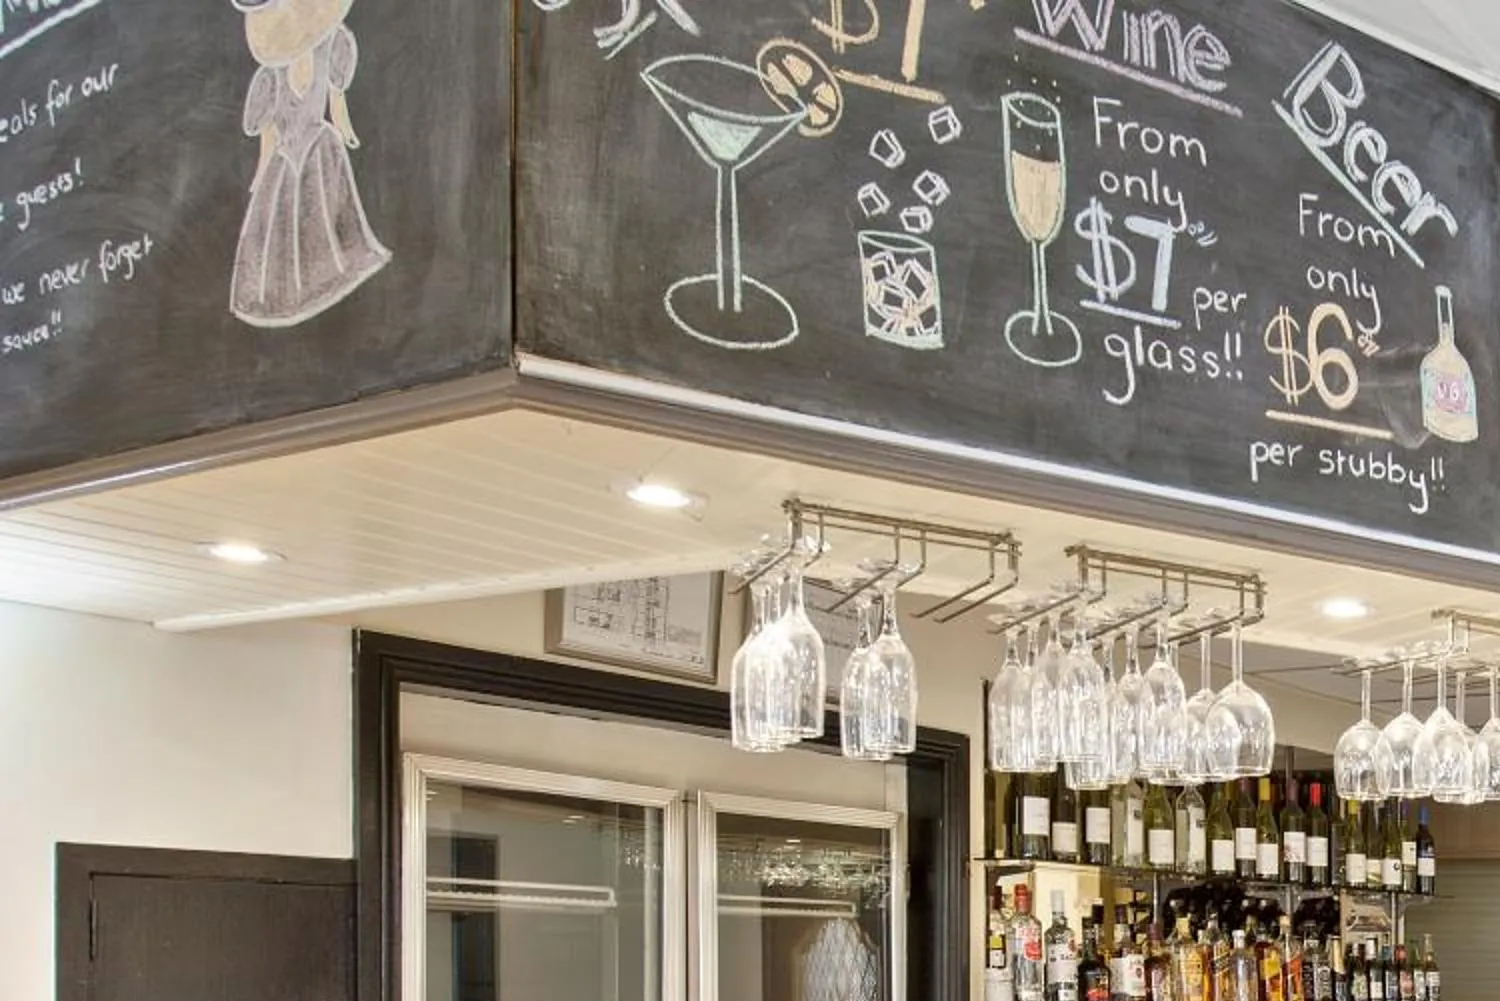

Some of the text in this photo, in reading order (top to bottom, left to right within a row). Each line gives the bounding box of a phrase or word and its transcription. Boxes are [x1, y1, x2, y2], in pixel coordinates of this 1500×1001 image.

[46, 79, 74, 127] for
[81, 63, 119, 97] our
[1092, 96, 1208, 166] From
[1284, 40, 1459, 239] Beer
[1099, 169, 1190, 233] only
[1298, 193, 1397, 257] From
[39, 258, 90, 295] never
[98, 233, 153, 283] forget
[1193, 286, 1247, 330] per
[1307, 265, 1381, 334] only
[1102, 325, 1243, 405] glass!!
[1250, 440, 1445, 514] per stubby!!
